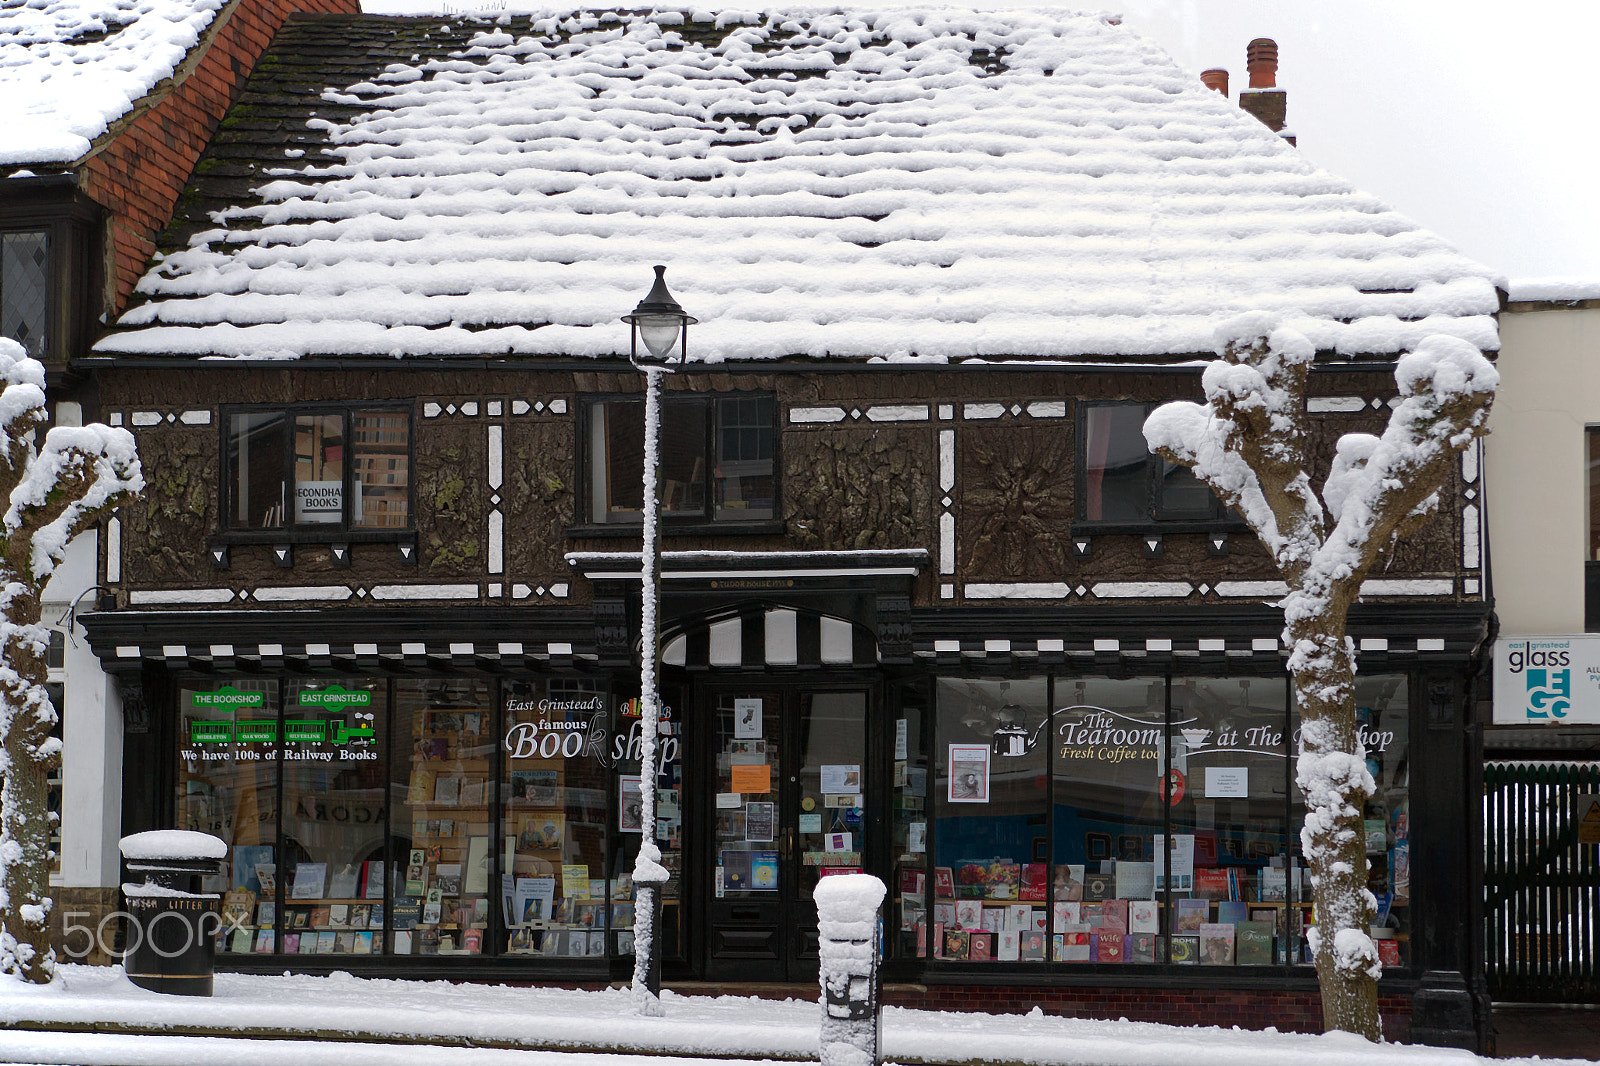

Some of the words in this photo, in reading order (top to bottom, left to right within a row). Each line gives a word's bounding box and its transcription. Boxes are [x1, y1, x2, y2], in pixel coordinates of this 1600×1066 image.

[296, 488, 342, 497] ECONDHA
[306, 498, 338, 507] BOOKS
[1531, 641, 1569, 650] grinstead
[1509, 641, 1570, 673] glass
[195, 695, 212, 704] THE
[213, 695, 262, 704] BOOKSHOP
[301, 694, 322, 703] EAST
[323, 694, 368, 703] GRINSTEAD
[506, 699, 534, 712] East
[538, 696, 603, 714] Grinstead's
[538, 719, 588, 730] famous
[1083, 712, 1114, 730] The
[1059, 721, 1161, 746] Tearoom
[1217, 729, 1238, 746] at
[1244, 725, 1282, 747] The
[505, 711, 608, 768] Book
[611, 720, 678, 776] shp
[181, 750, 199, 761] We
[202, 750, 231, 761] have
[235, 750, 261, 761] 100s
[264, 750, 279, 761] of
[284, 750, 334, 763] Railway
[339, 750, 378, 761] Books
[1060, 746, 1094, 760] Fresh
[1098, 746, 1138, 763] Coffee
[1141, 748, 1161, 760] too
[169, 900, 202, 910] LITTER
